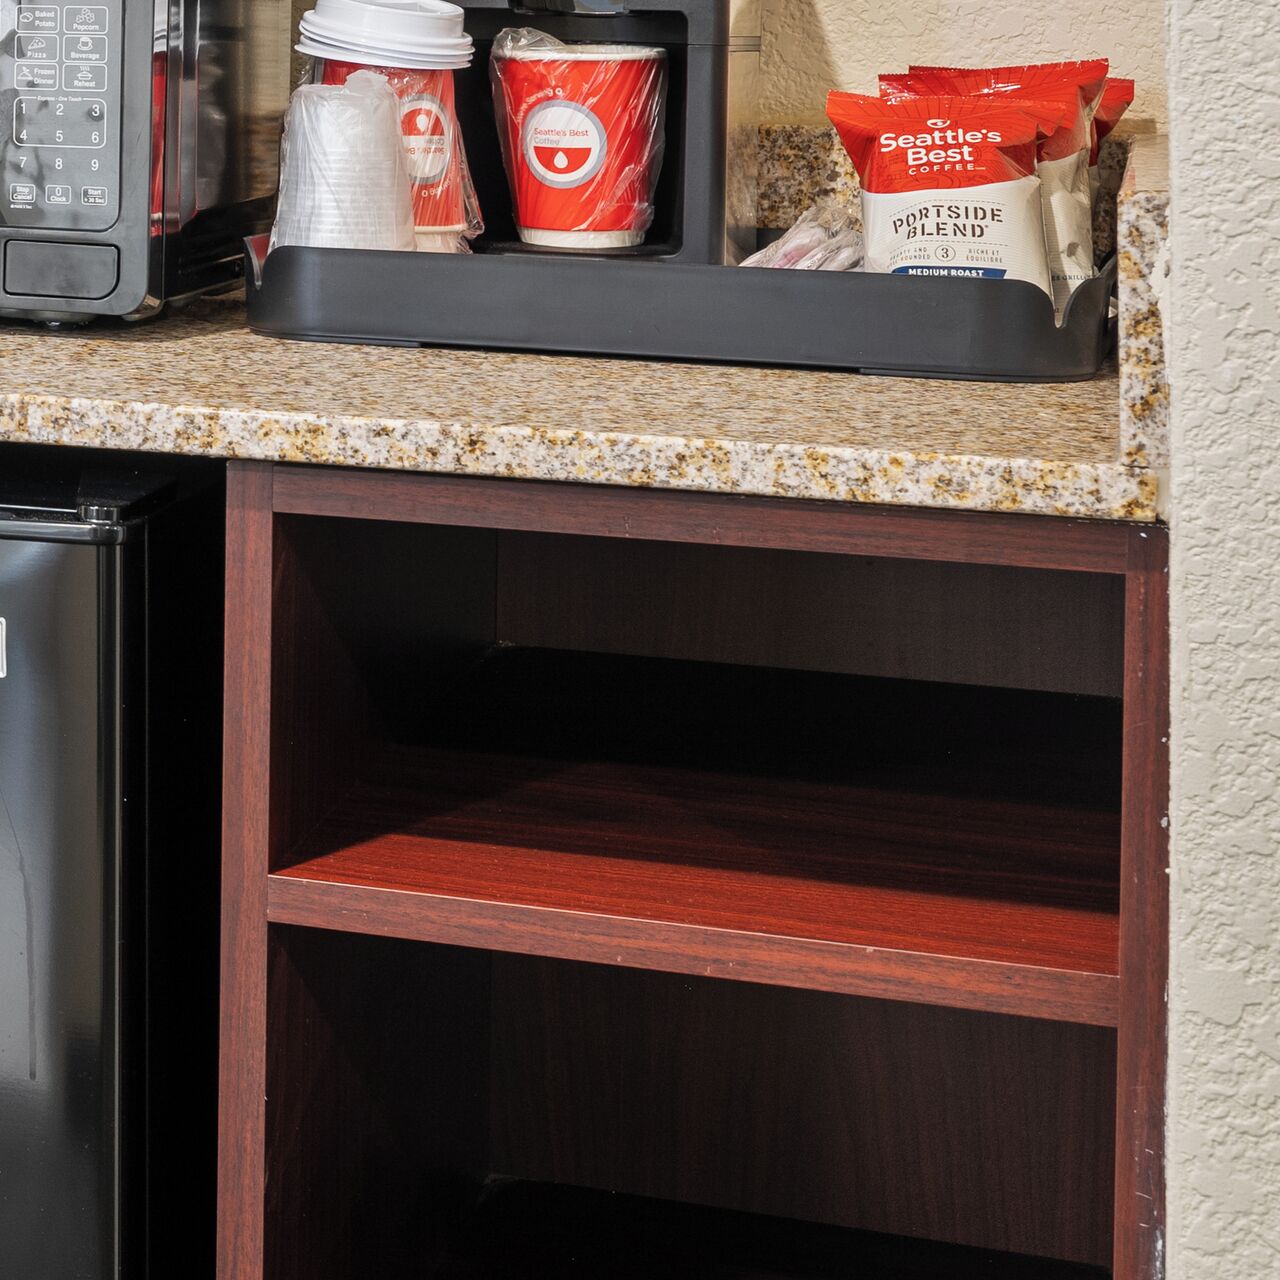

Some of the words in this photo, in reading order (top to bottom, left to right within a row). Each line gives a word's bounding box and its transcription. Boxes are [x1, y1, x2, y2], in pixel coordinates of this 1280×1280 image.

[73, 23, 99, 31] Popcorn
[70, 51, 100, 60] Beverage
[20, 102, 26, 114] 1
[56, 103, 65, 115] 2
[91, 104, 100, 116] 3
[20, 129, 28, 140] 4
[55, 130, 64, 142] 5
[91, 131, 100, 143] 6
[534, 128, 568, 137] Seattle's
[569, 129, 589, 137] Best
[879, 128, 1002, 152] Seattle's
[907, 145, 975, 165] Best
[19, 156, 27, 168] 7
[55, 157, 63, 170] 8
[91, 159, 99, 171] 9
[908, 163, 975, 175] COFFEE
[55, 187, 62, 196] 0
[893, 205, 1003, 234] PORTSIDE
[907, 222, 985, 240] BLEND
[941, 247, 949, 259] 3
[908, 268, 949, 276] MEDIUM
[951, 269, 985, 277] ROAST
